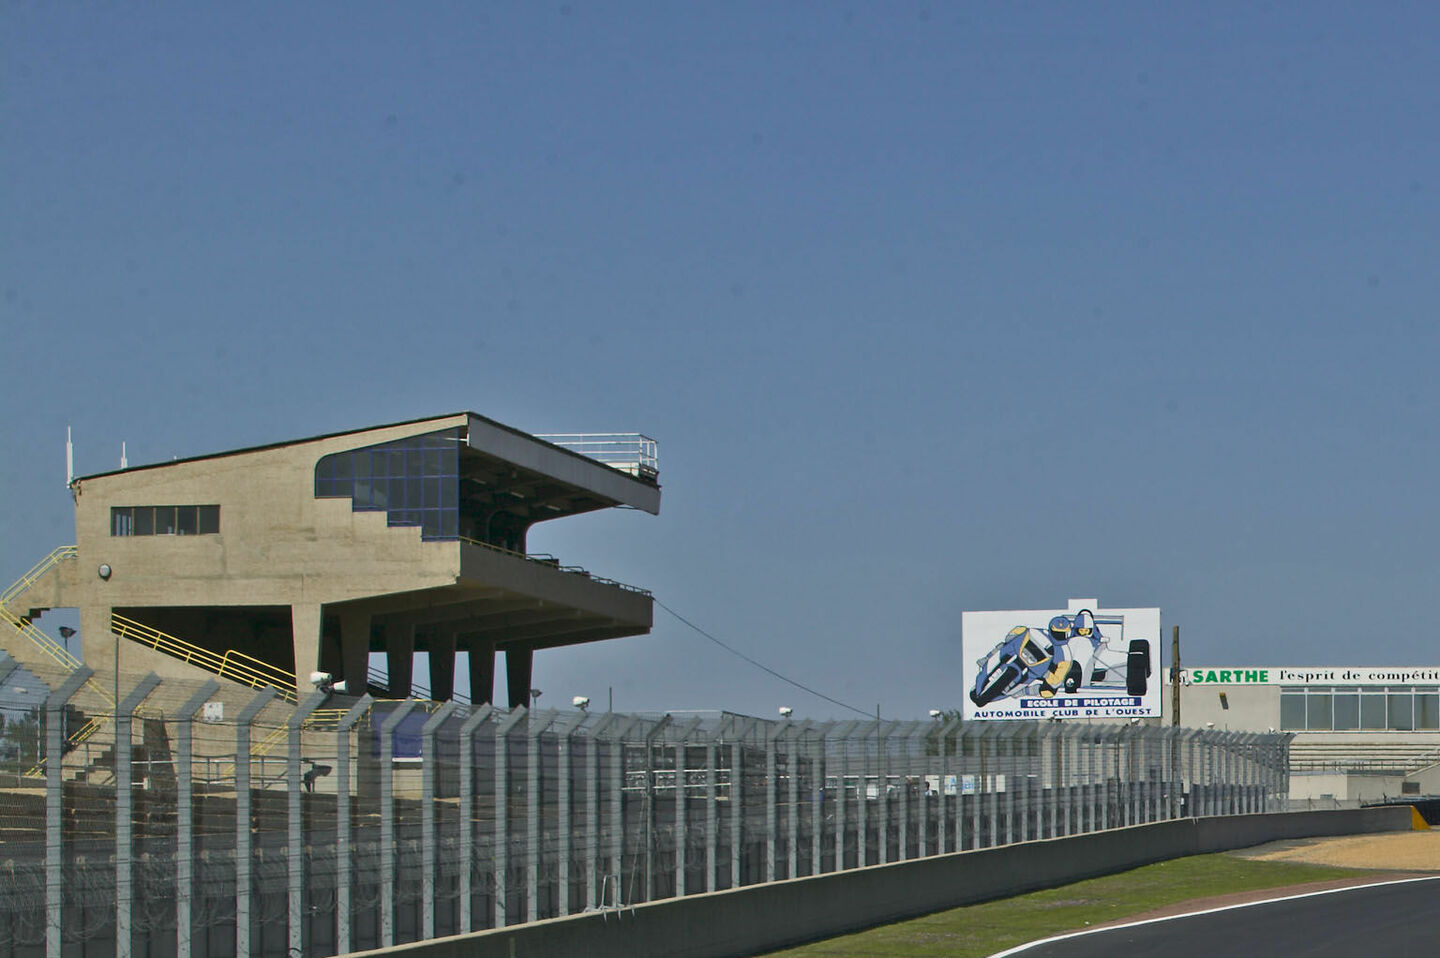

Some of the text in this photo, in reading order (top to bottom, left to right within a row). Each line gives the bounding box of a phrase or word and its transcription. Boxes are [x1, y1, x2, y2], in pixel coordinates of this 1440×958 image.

[1193, 670, 1269, 683] SARTHE
[1280, 670, 1335, 685] l'esprit
[1342, 670, 1361, 681] de
[1026, 697, 1136, 708] ECOLE DE PILOTAGE
[974, 710, 1045, 718] AUTOMOBILE
[1052, 709, 1079, 717] CLUB
[1086, 708, 1099, 716] DE
